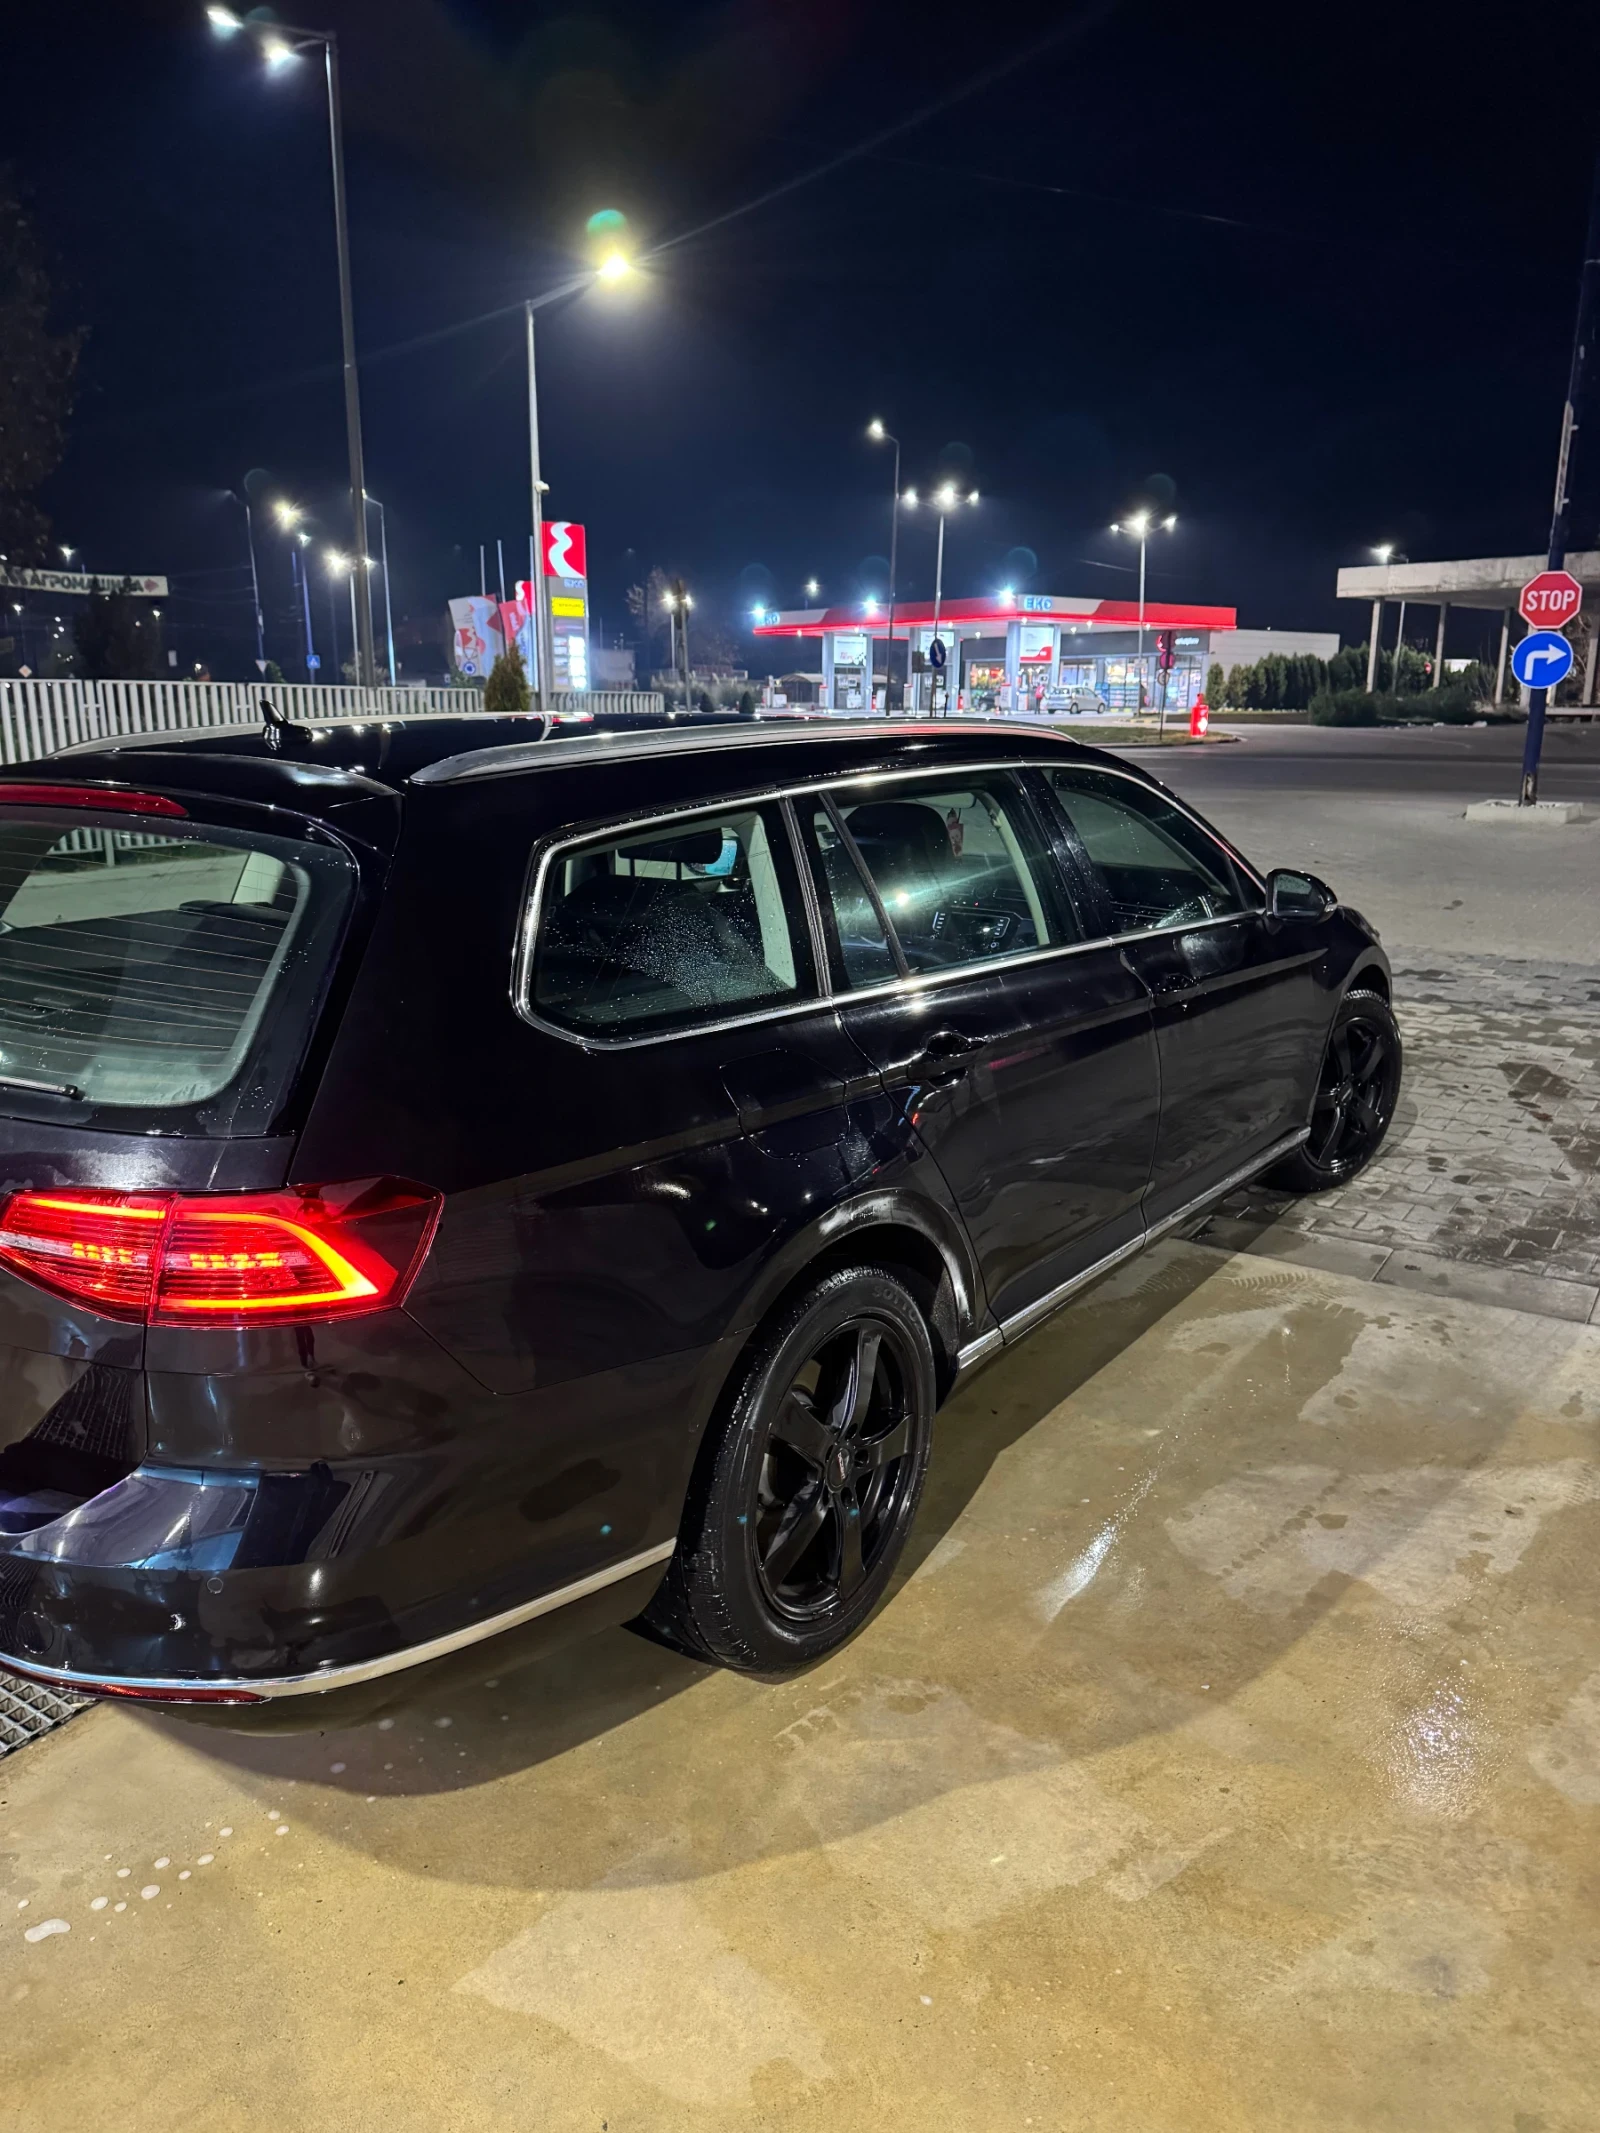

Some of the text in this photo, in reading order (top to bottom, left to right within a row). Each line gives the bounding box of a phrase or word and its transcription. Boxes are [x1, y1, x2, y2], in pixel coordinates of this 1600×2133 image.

[30, 569, 145, 593] АГРОМШИА
[1024, 595, 1052, 611] EKO
[1525, 589, 1575, 611] STOP
